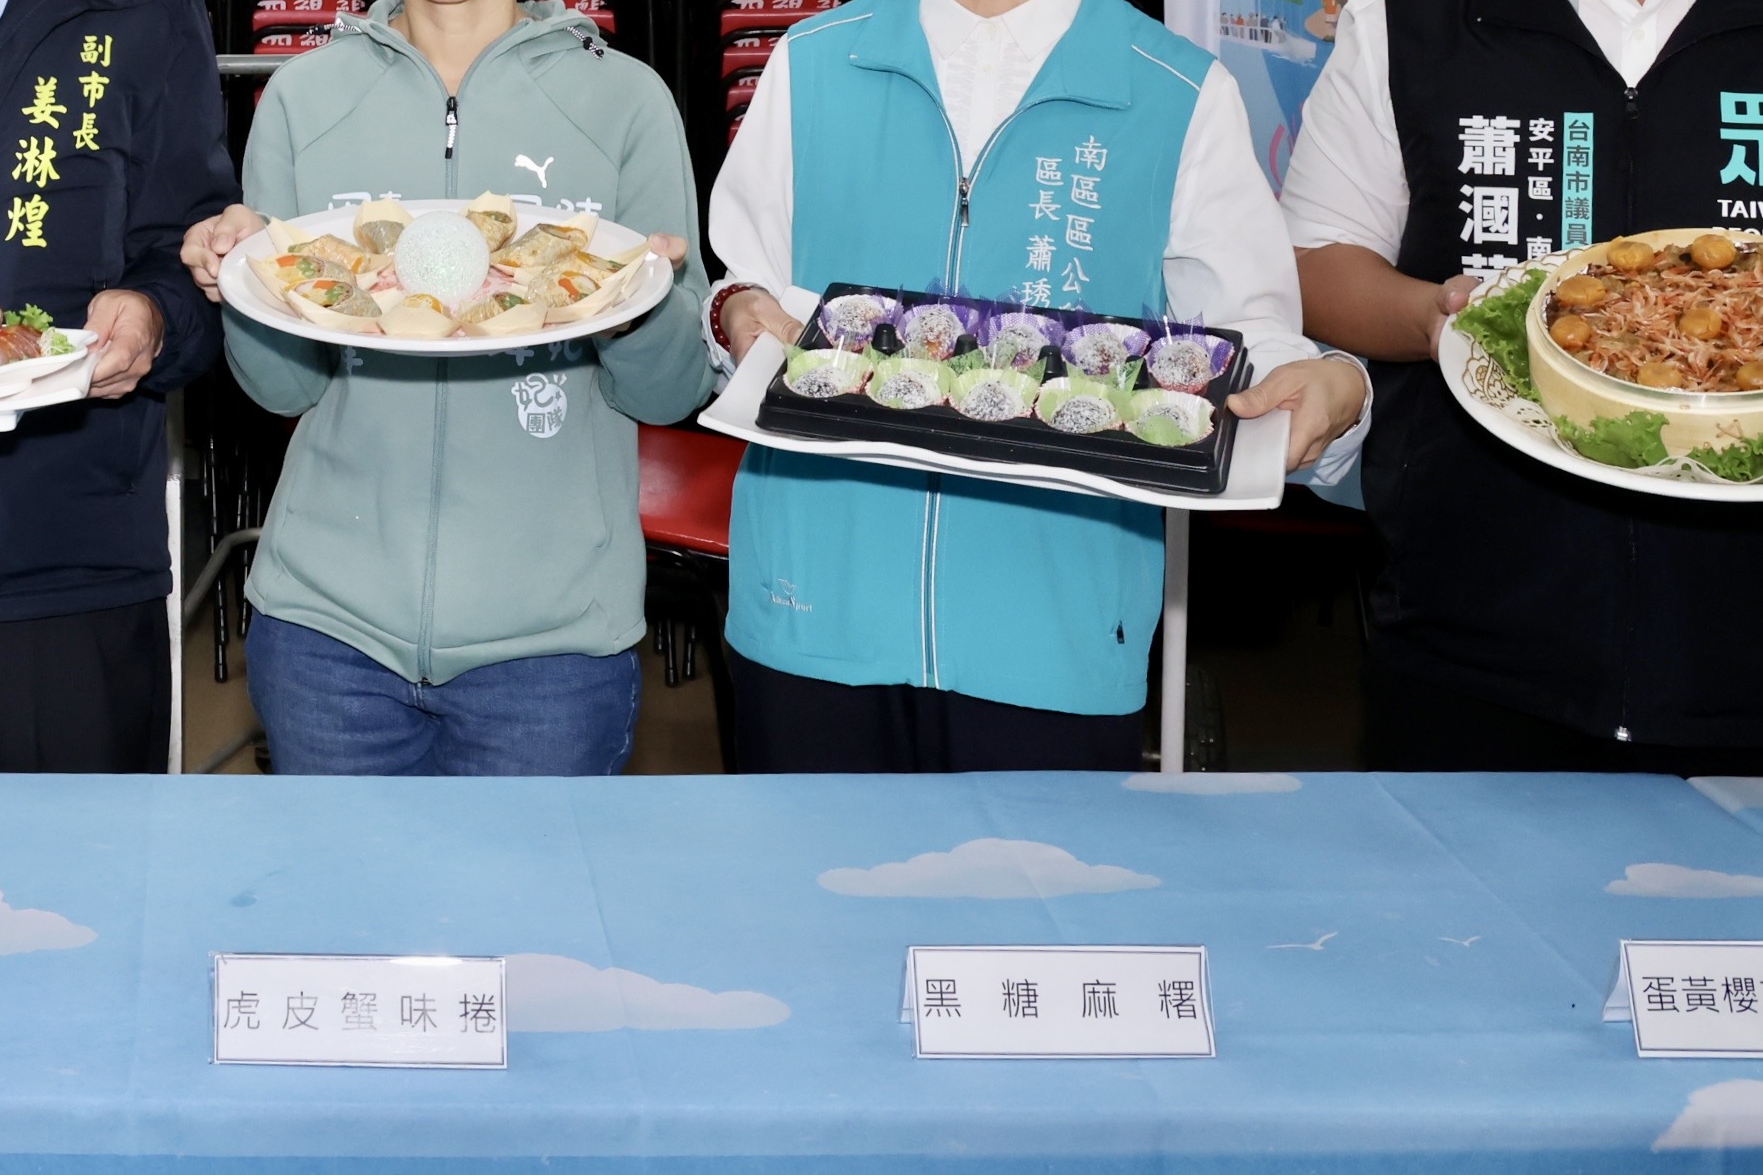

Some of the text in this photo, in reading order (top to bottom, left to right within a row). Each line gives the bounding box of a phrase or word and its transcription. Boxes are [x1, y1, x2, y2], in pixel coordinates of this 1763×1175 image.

[72, 35, 113, 151] 副市長
[4, 76, 68, 248] 姜淋煌
[1028, 157, 1064, 221] 區長
[1564, 120, 1590, 245] 台南市議員
[1059, 135, 1108, 311] 南區區公
[223, 990, 497, 1034] 虎皮蟹味捲
[924, 978, 1197, 1019] 黑糖麻糬
[1642, 976, 1763, 1013] 蛋黃櫻
